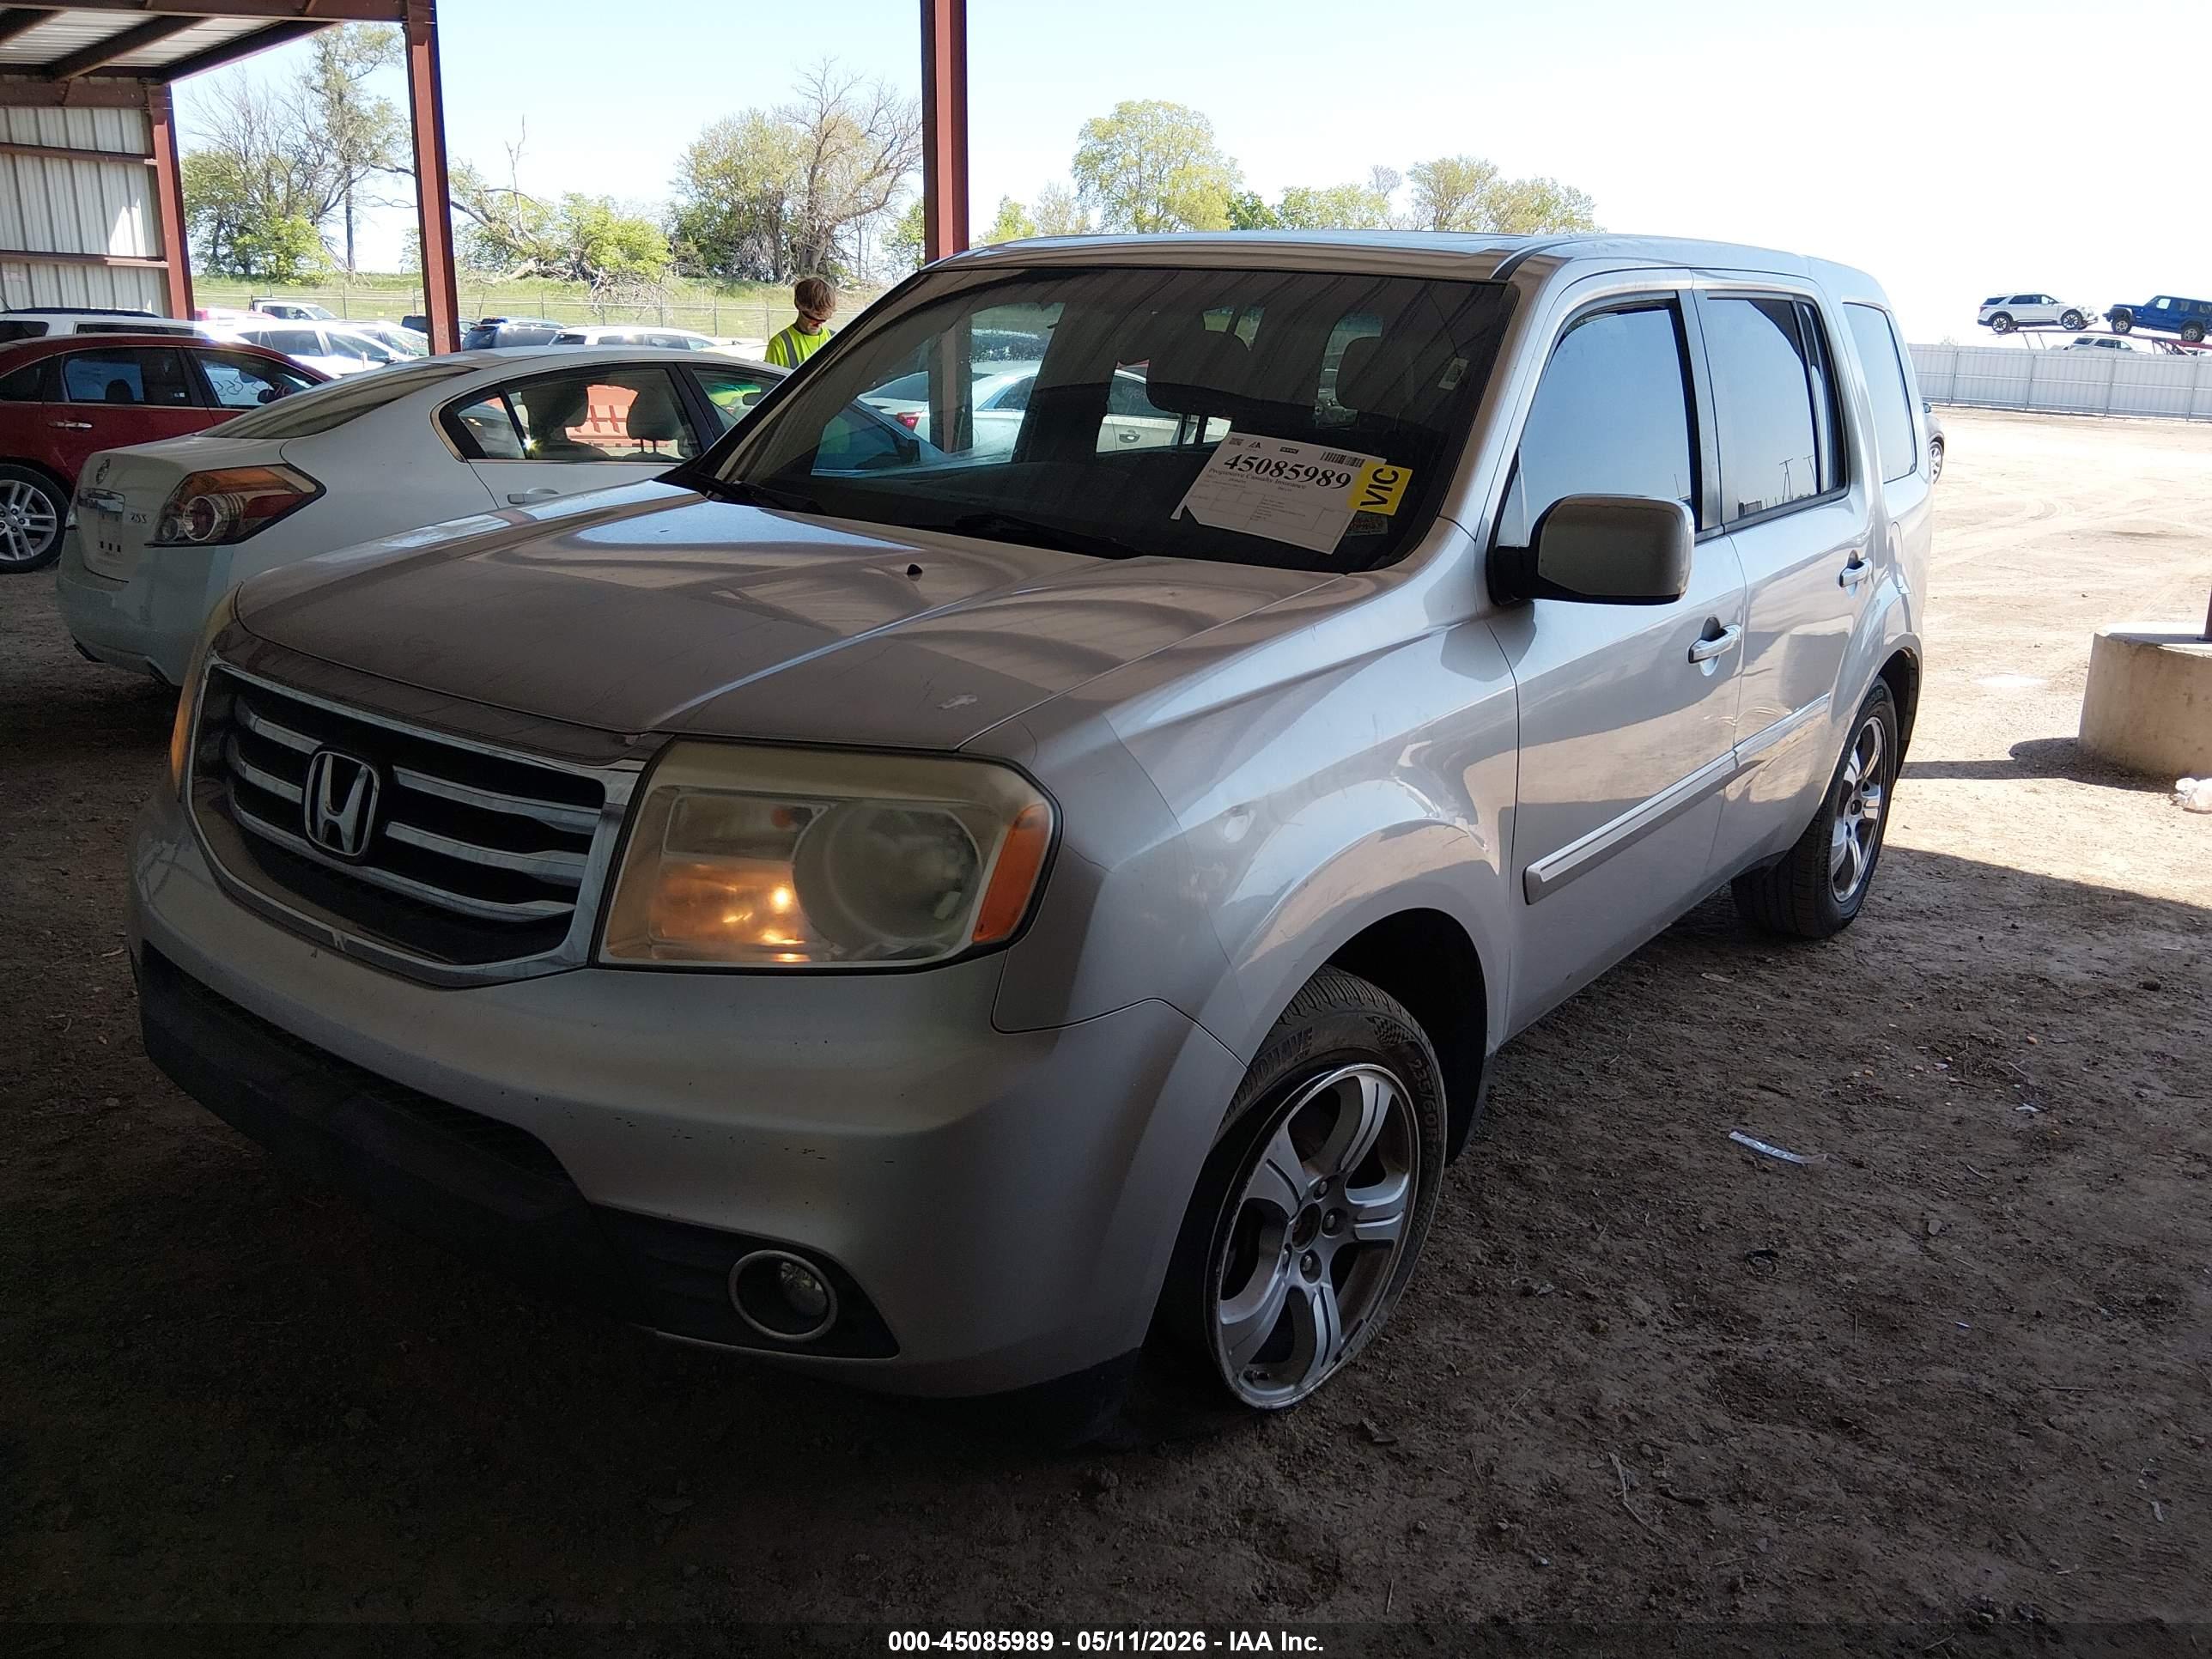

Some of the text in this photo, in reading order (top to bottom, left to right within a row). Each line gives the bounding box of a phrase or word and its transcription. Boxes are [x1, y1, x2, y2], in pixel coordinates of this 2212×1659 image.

[1209, 467, 1247, 479] Progressive
[1246, 472, 1273, 483] Casualty
[1275, 478, 1306, 489] Insurance
[1224, 453, 1352, 489] 45085989
[1359, 468, 1399, 507] VIC
